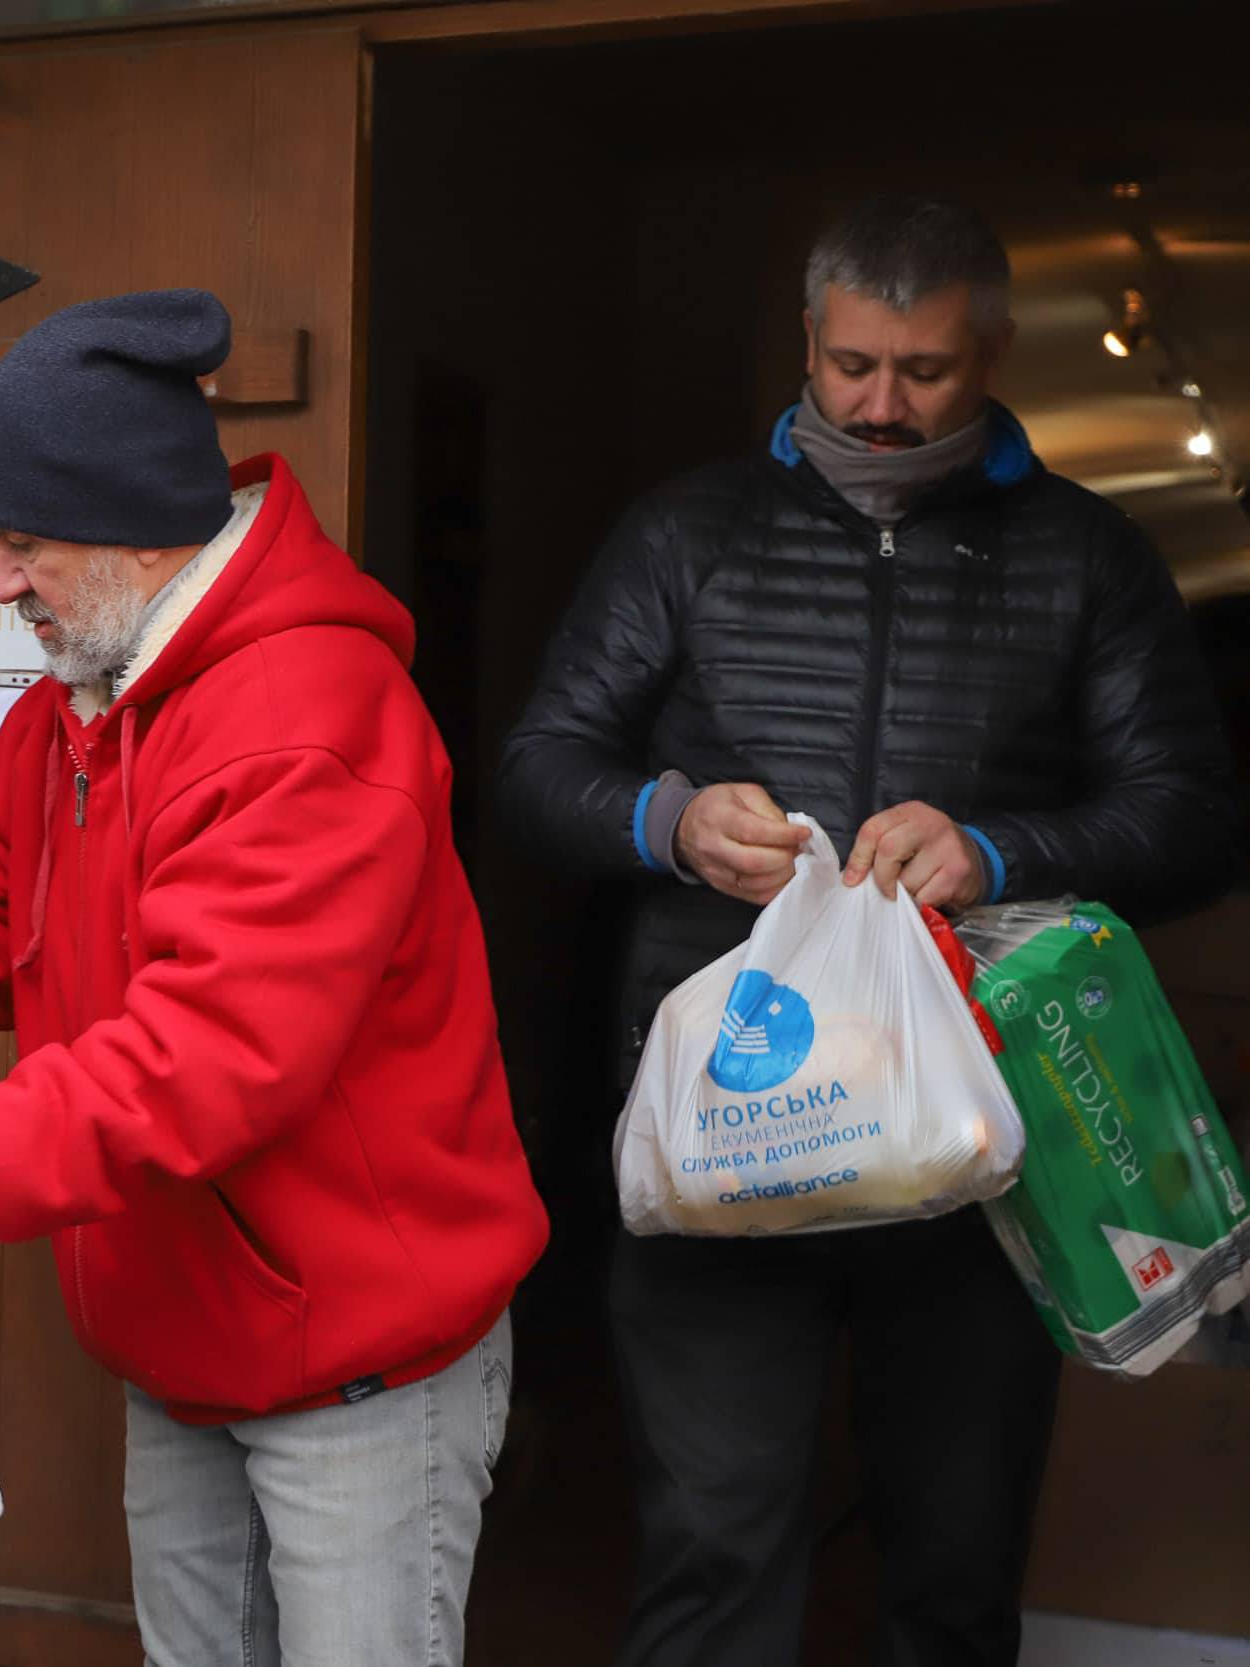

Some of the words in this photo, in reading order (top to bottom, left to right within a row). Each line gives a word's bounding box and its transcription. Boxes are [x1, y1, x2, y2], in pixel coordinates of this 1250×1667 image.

[697, 1079, 849, 1132] УГОРСЬКА
[1036, 999, 1143, 1186] RECYCLING
[681, 1150, 758, 1173] СЛУЖБА
[764, 1120, 882, 1165] ДОПОМОГИ
[710, 1111, 835, 1151] ЕКУМЕНІЧНА
[718, 1167, 859, 1205] actalliance
